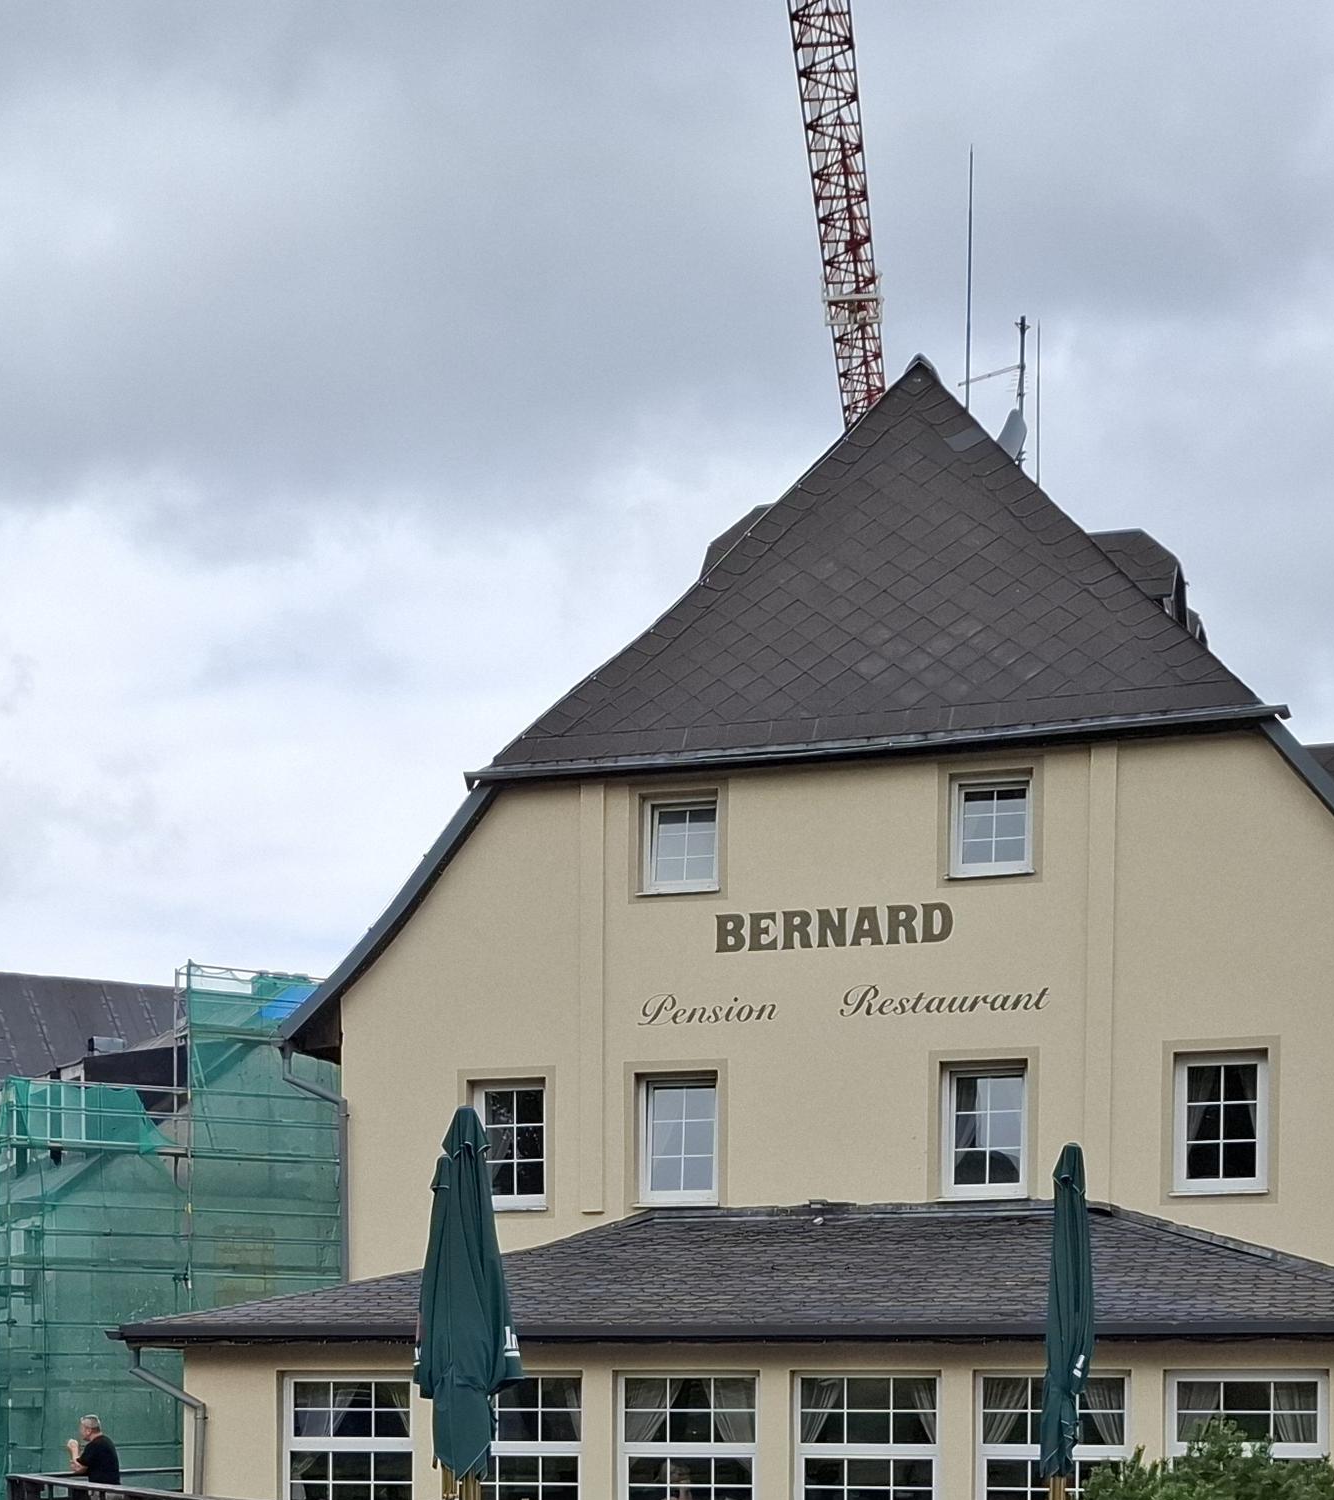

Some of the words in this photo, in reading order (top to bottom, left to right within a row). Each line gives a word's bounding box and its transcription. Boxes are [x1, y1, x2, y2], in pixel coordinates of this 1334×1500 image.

[715, 901, 954, 953] BERNARD
[637, 992, 777, 1026] Pension
[839, 984, 1050, 1017] Restaurant
